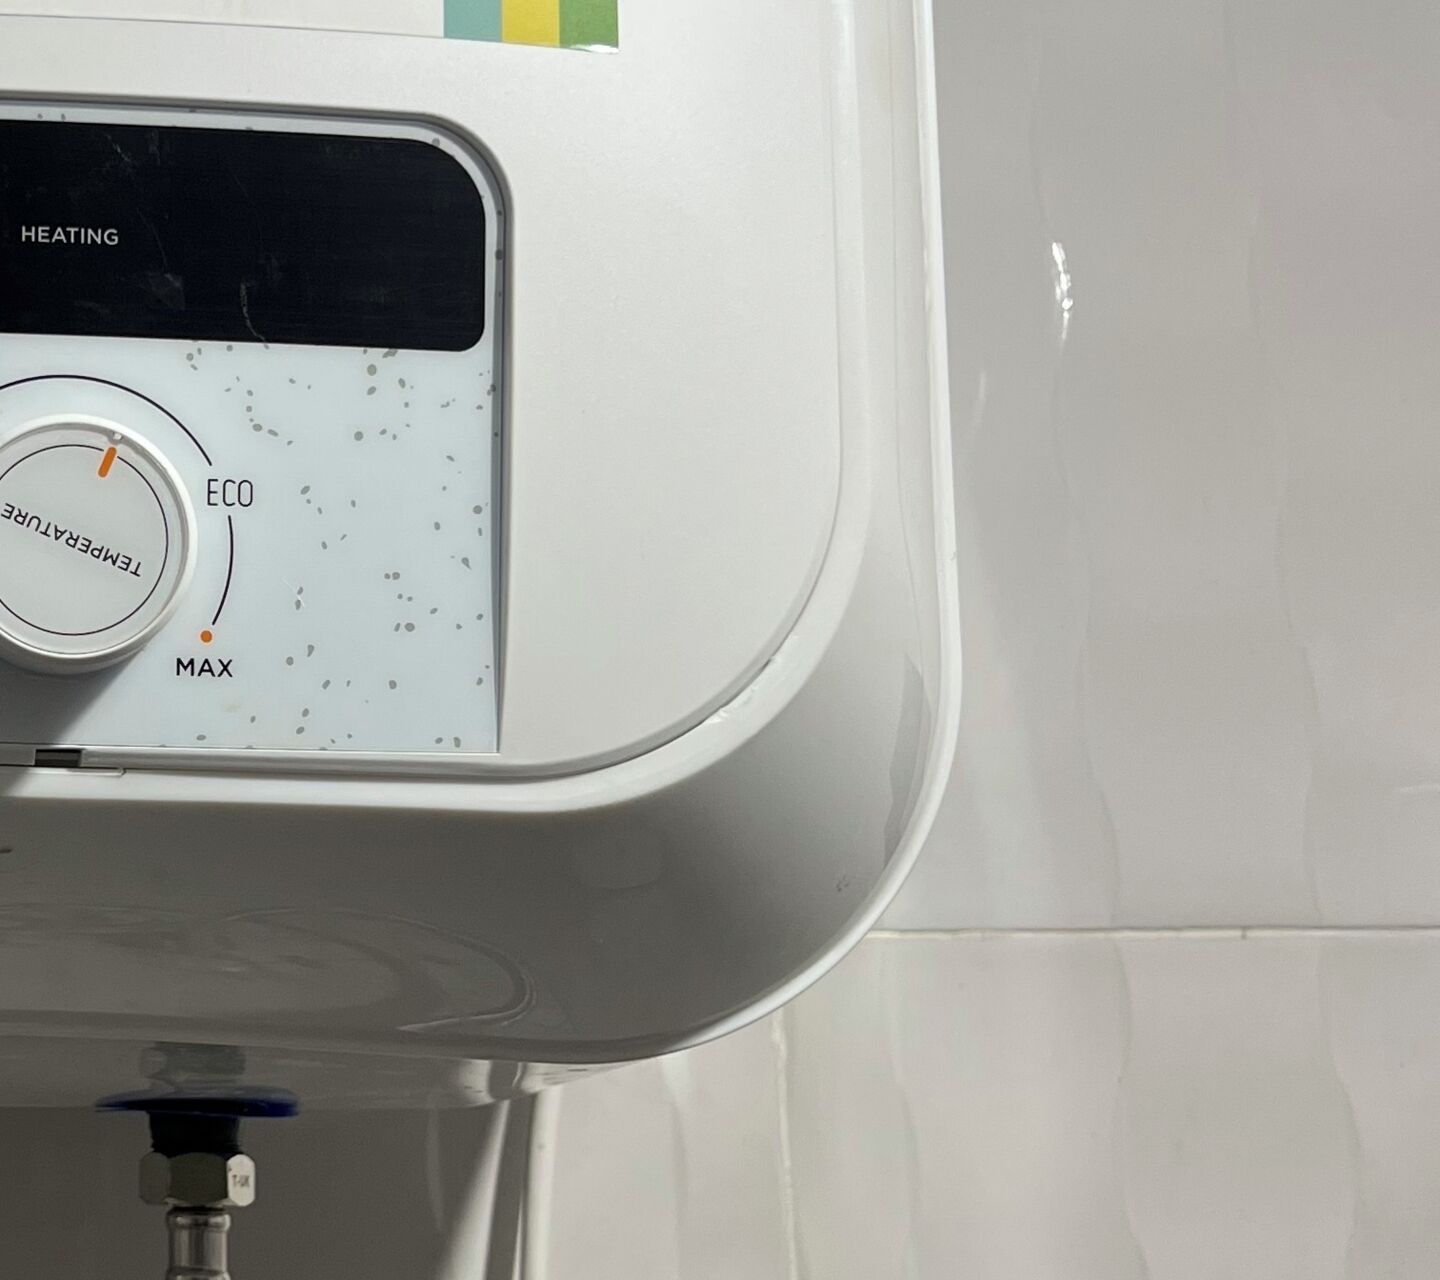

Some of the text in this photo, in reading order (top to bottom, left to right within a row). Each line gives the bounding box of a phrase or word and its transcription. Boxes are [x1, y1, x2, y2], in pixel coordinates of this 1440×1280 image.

[21, 225, 119, 246] HEATING
[207, 478, 254, 508] ECO
[0, 502, 142, 578] TEMPERATURE
[176, 657, 233, 678] MAX
